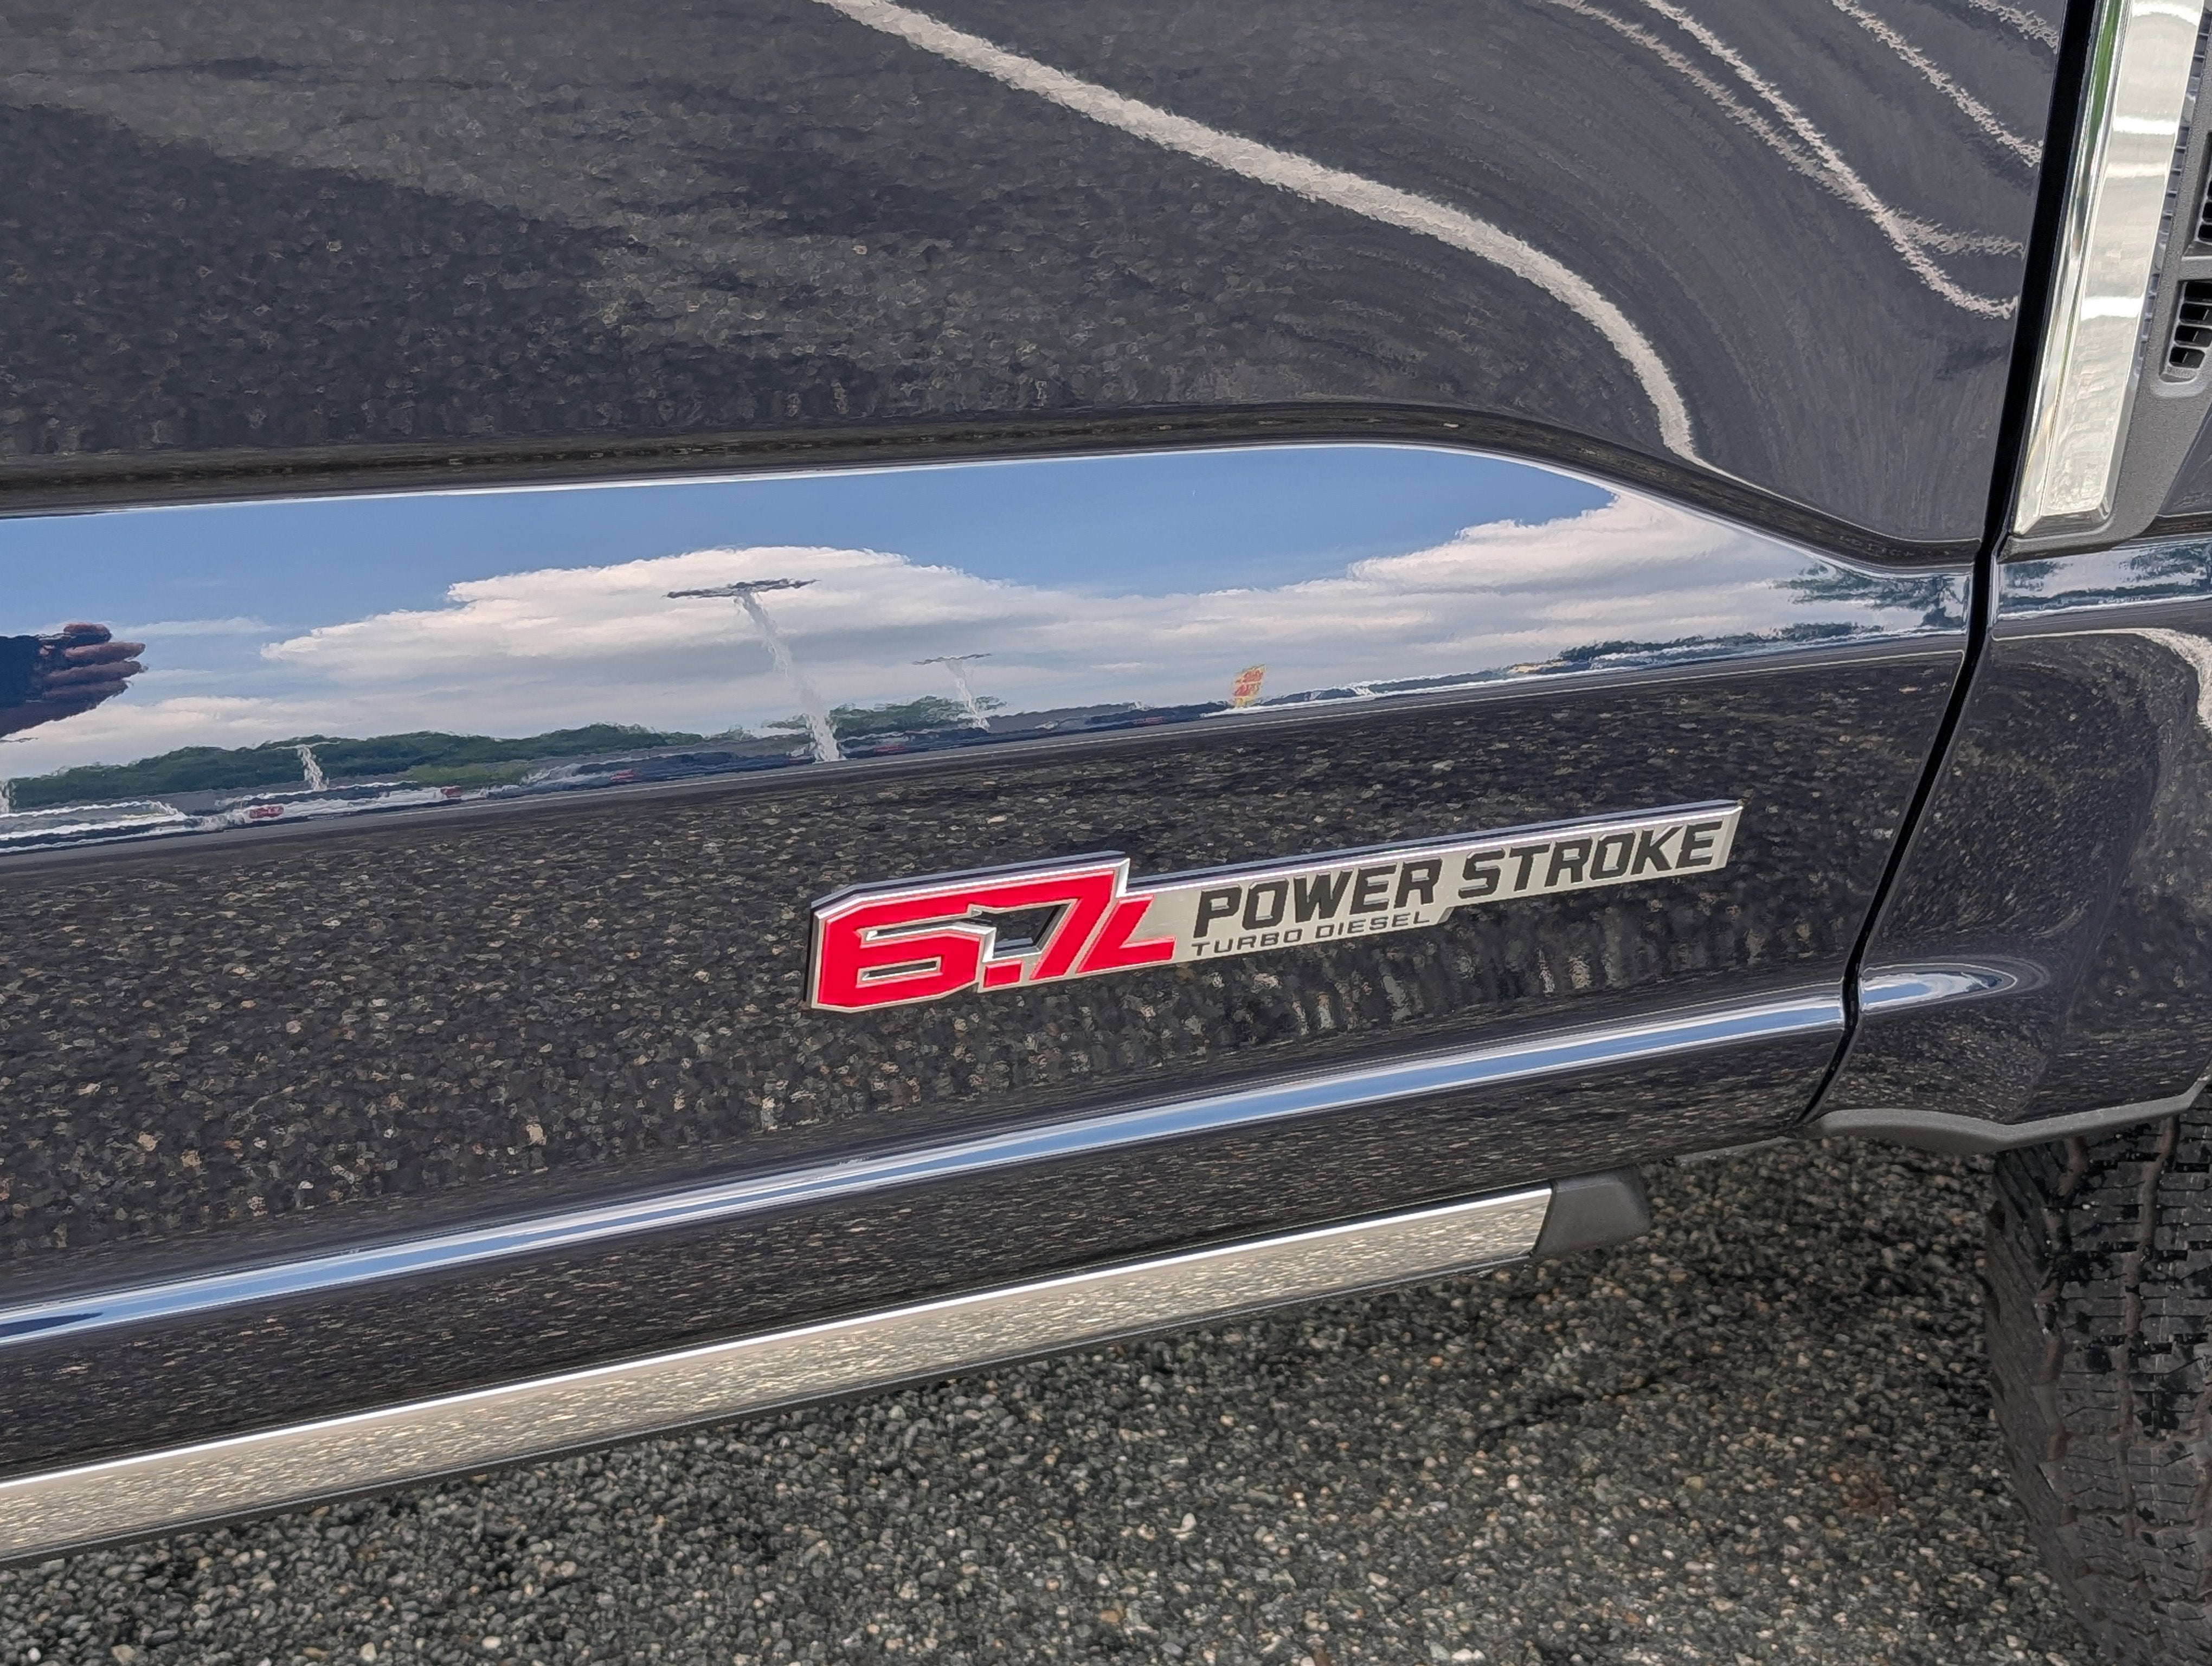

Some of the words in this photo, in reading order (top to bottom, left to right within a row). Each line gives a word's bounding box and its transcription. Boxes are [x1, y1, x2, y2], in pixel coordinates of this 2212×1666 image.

[816, 869, 1175, 1007] 6.7L
[1193, 855, 1442, 938] POWER
[1461, 820, 1724, 900] STROKE
[1192, 927, 1306, 956] TURBO
[1315, 911, 1430, 938] DIESEL
